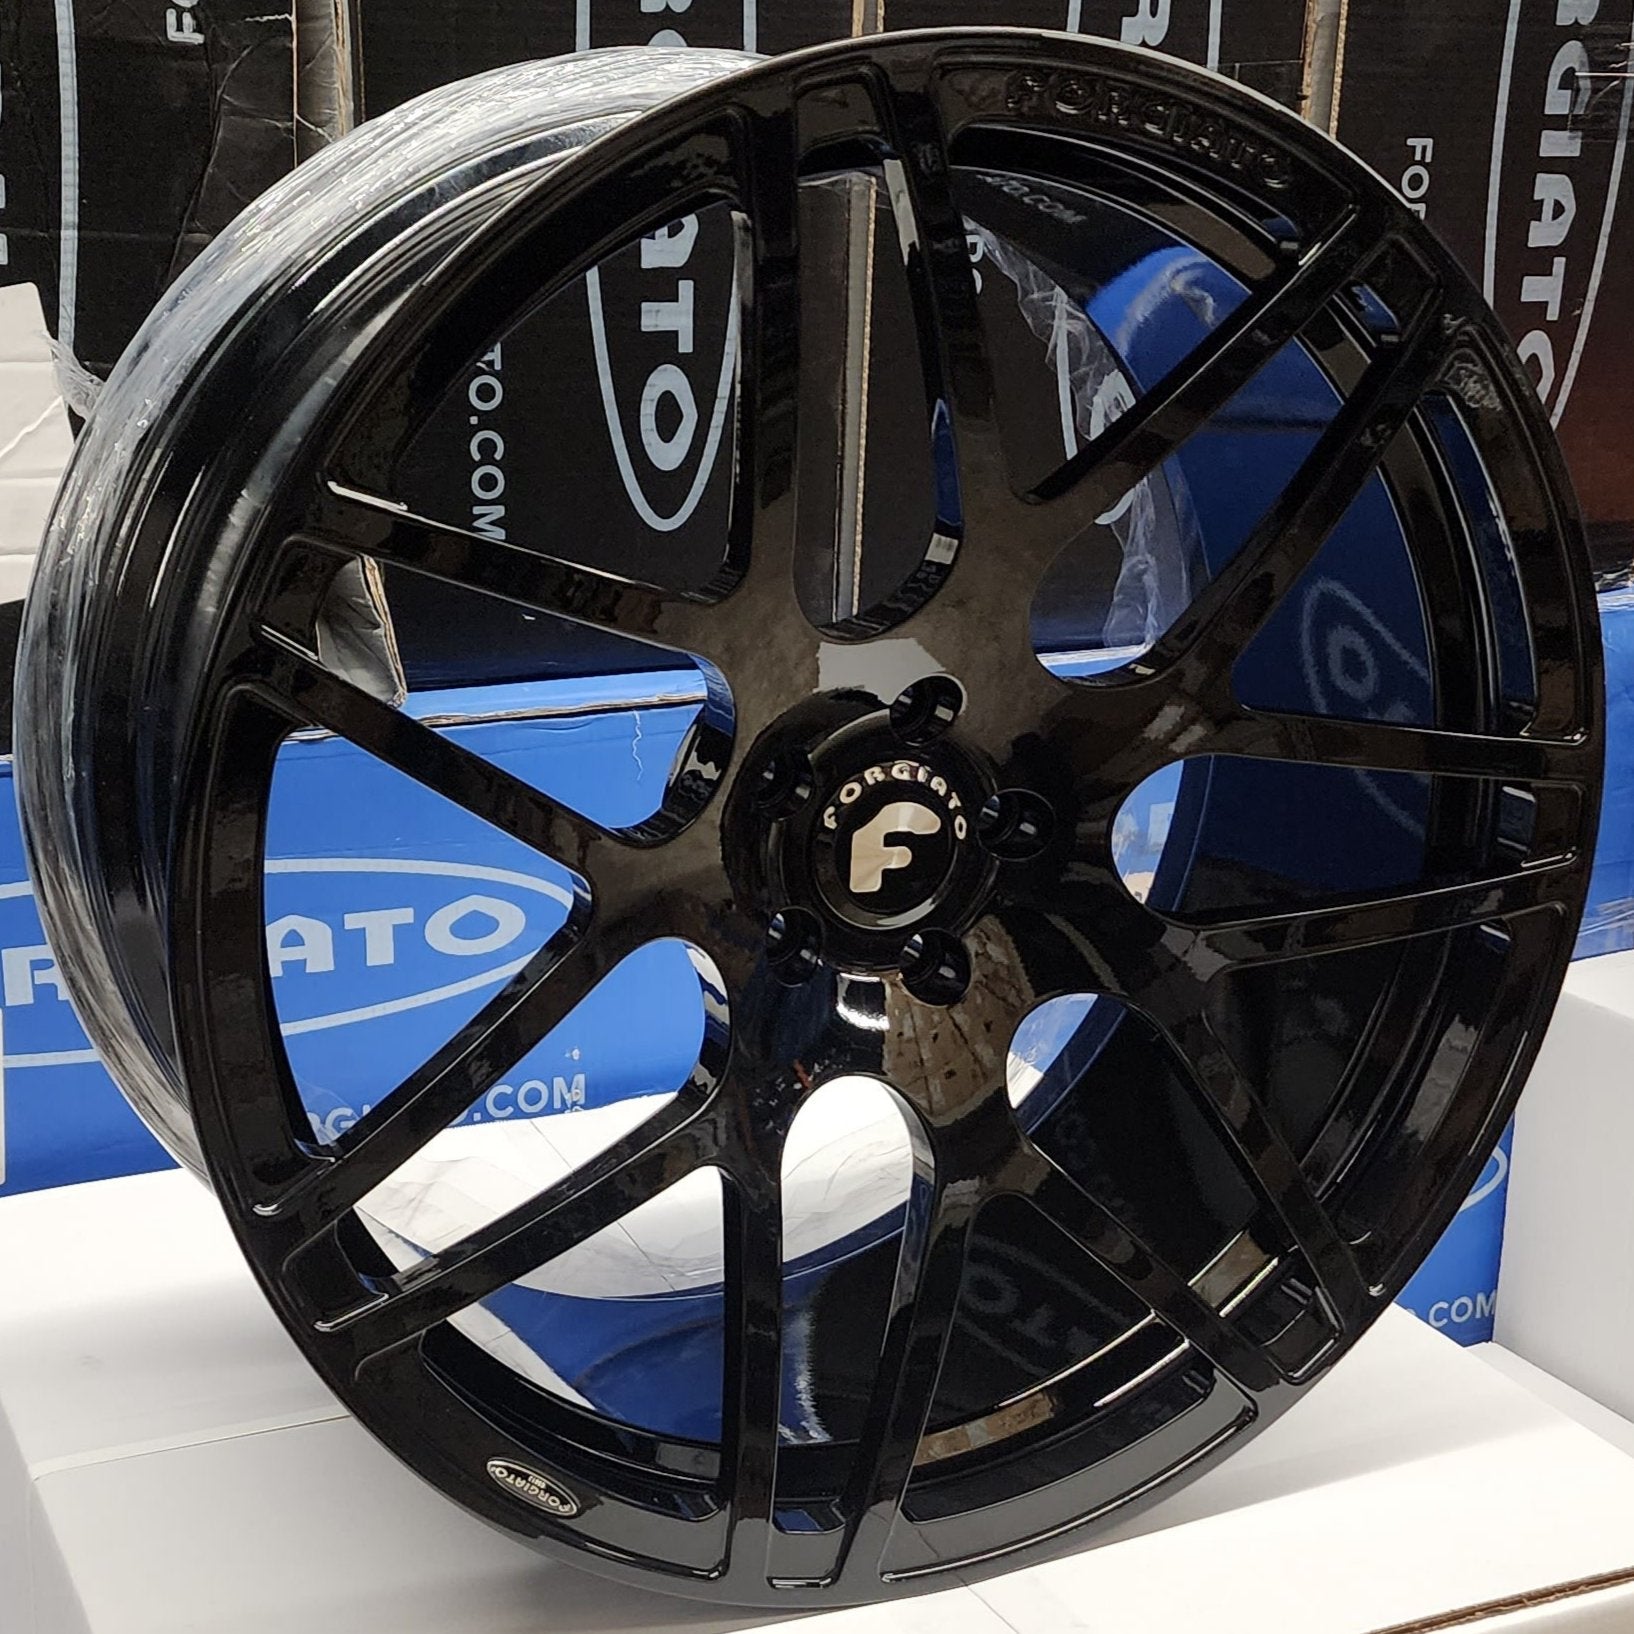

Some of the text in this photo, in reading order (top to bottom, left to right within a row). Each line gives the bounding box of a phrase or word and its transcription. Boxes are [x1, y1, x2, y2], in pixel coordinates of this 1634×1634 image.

[823, 760, 967, 840] FORGIATO
[452, 1073, 586, 1126] .COM
[493, 1466, 571, 1512] FORGIATO
